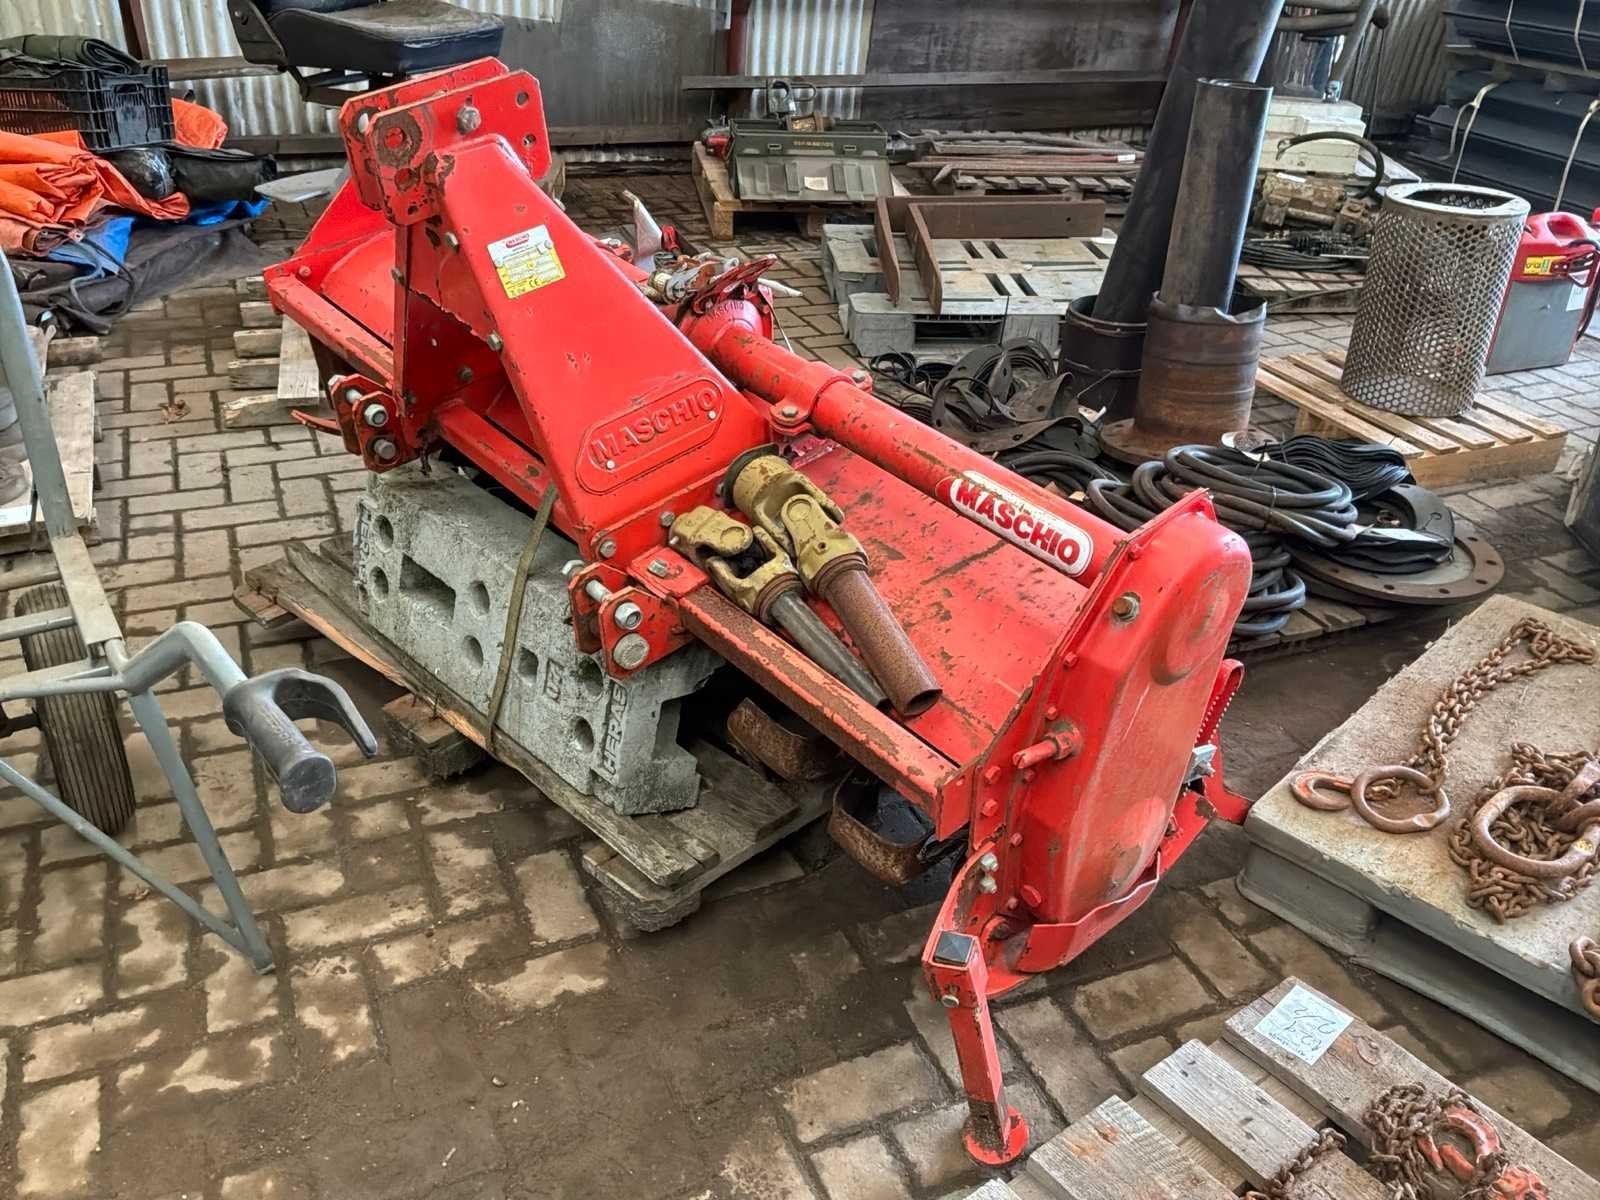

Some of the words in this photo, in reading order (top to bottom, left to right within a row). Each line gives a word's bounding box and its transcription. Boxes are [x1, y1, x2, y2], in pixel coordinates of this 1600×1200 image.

[590, 388, 717, 465] MASCHIO
[956, 480, 1080, 566] MASCHIO
[602, 681, 628, 777] HERAS
